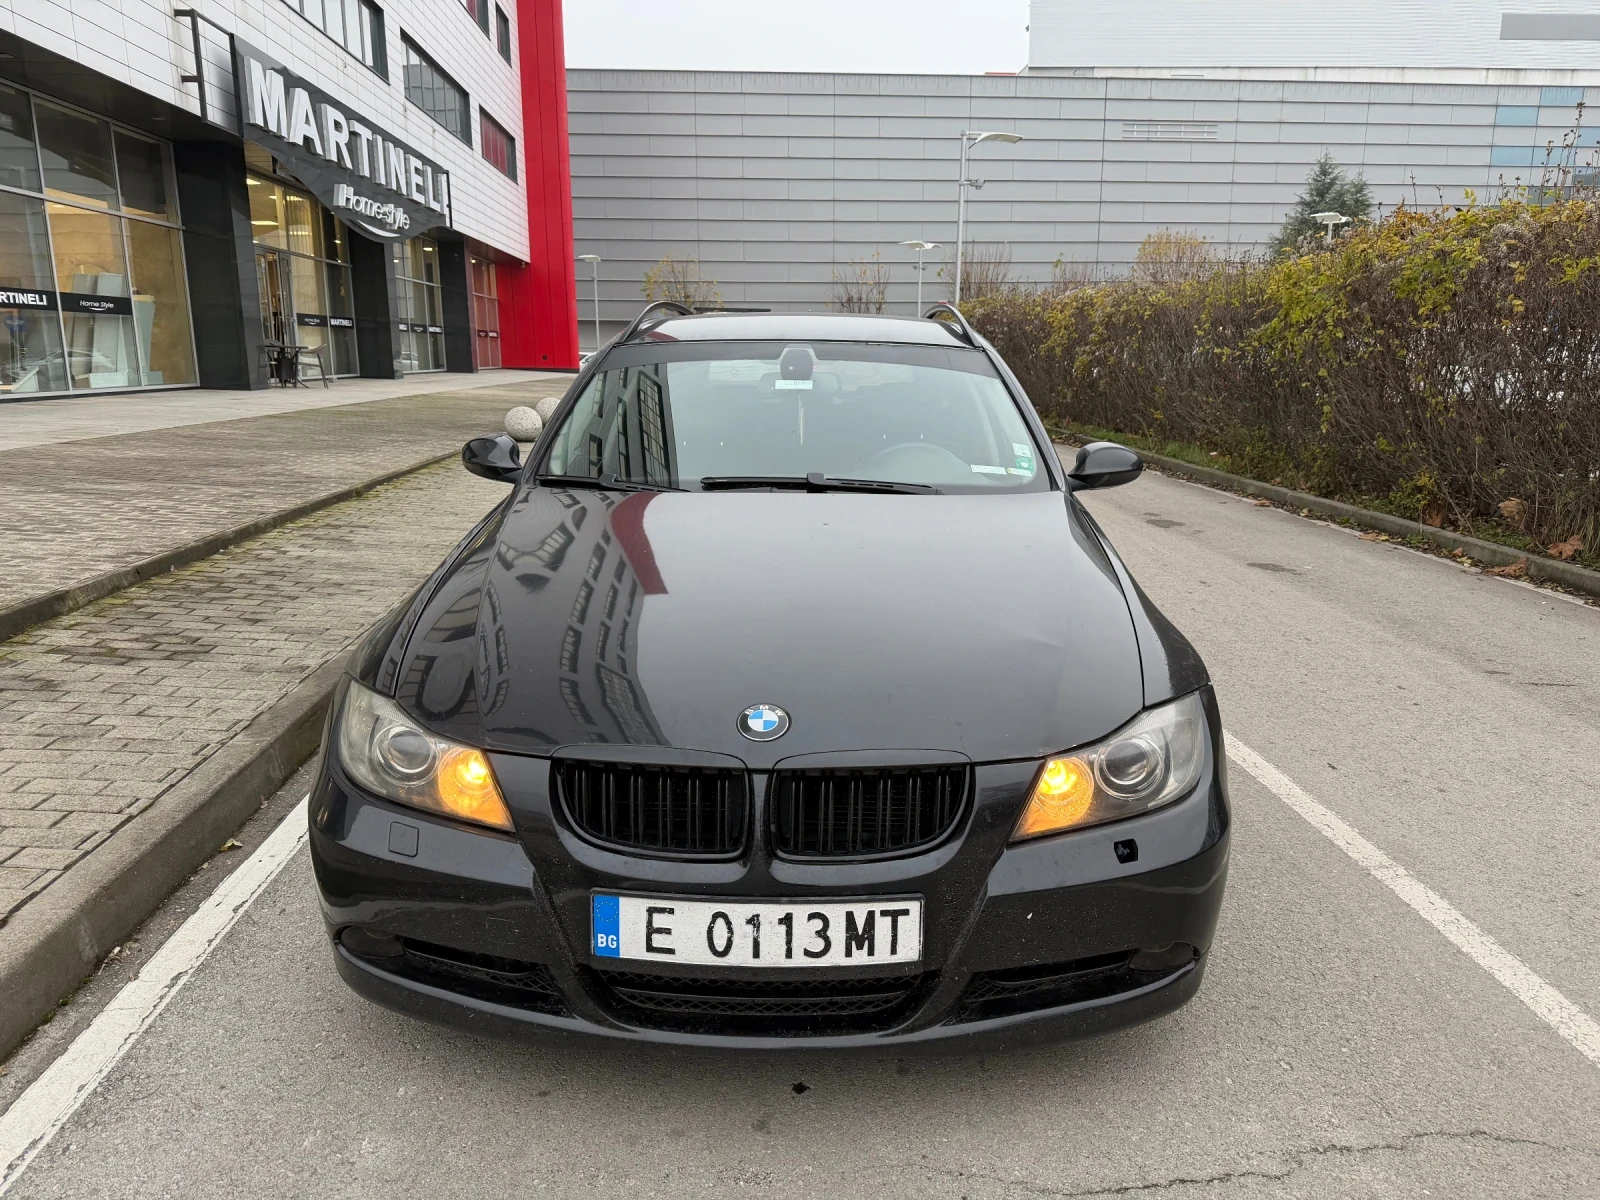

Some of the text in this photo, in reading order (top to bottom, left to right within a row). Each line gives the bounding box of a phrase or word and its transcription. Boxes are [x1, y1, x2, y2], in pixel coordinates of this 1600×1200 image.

[245, 56, 450, 227] MARTINELI
[744, 704, 784, 716] BMW
[597, 933, 617, 949] BG
[645, 905, 676, 955] E
